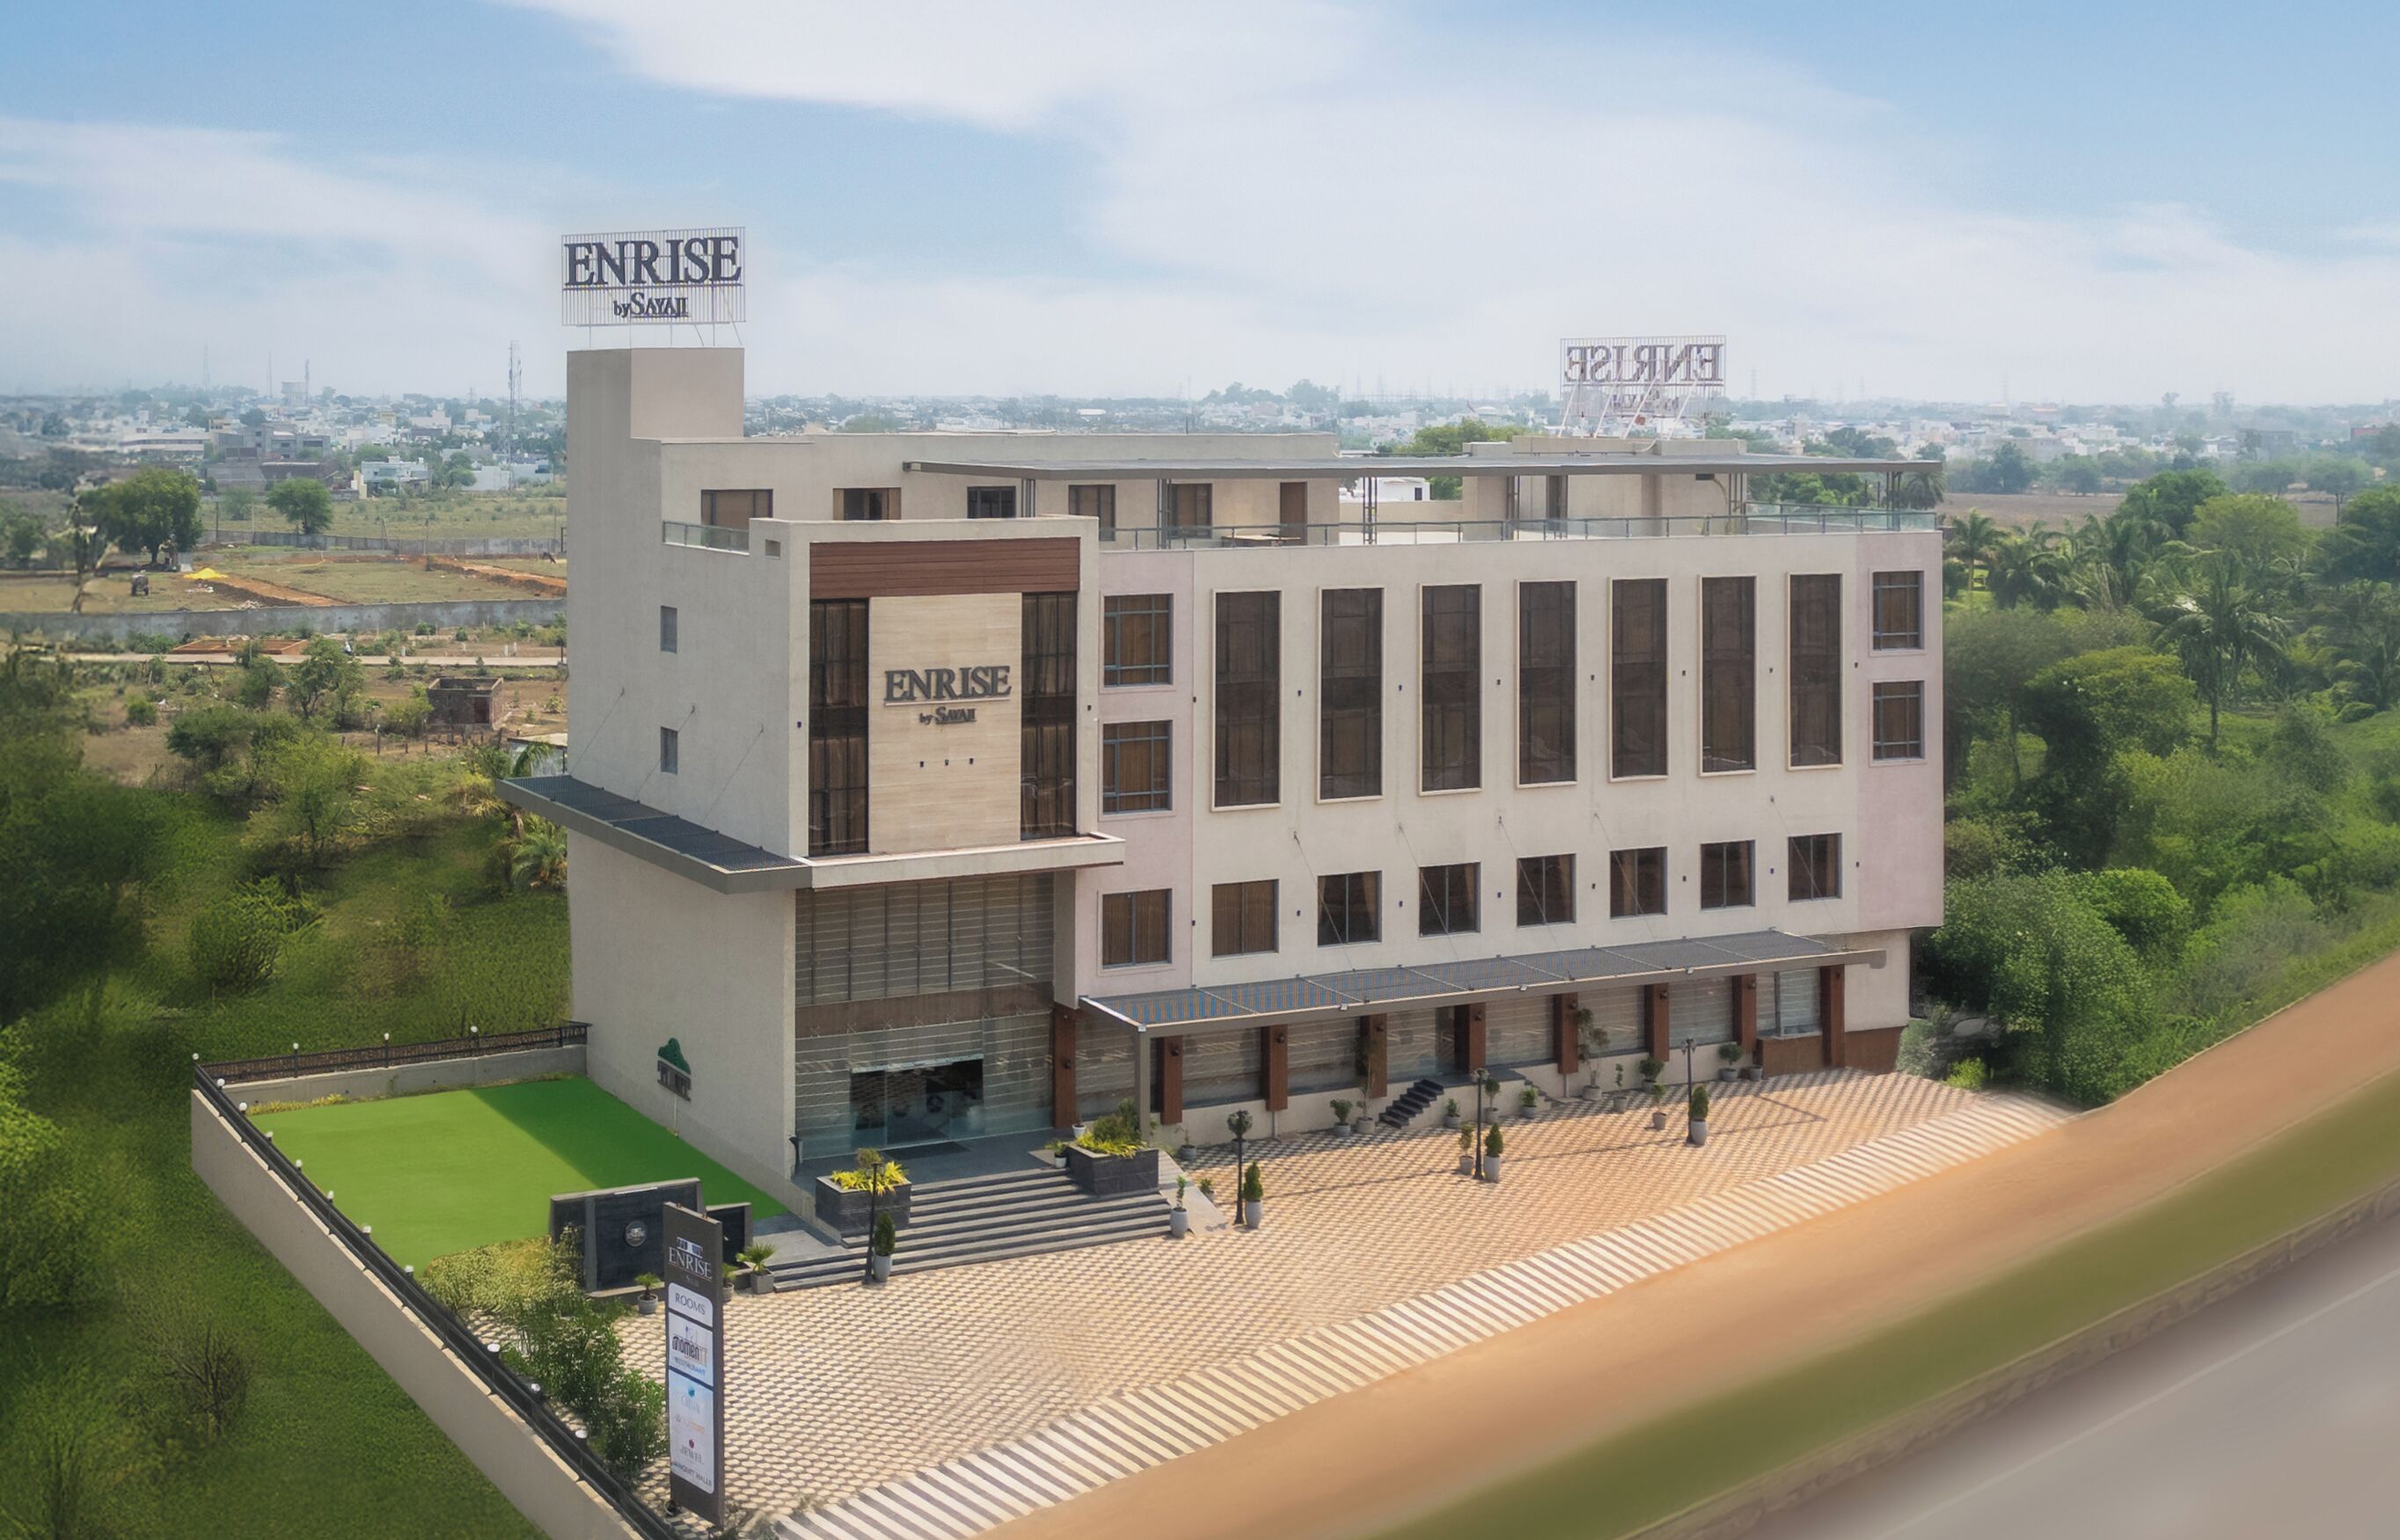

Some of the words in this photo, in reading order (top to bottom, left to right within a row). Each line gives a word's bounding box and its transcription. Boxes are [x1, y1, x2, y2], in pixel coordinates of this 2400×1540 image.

[564, 237, 742, 286] ENRISE
[613, 301, 631, 317] by
[630, 292, 689, 317] SAYAJI
[884, 666, 1012, 702] ENRISE
[919, 712, 933, 725] by
[669, 1246, 713, 1280] ENRISE
[675, 1293, 706, 1316] ROOMS
